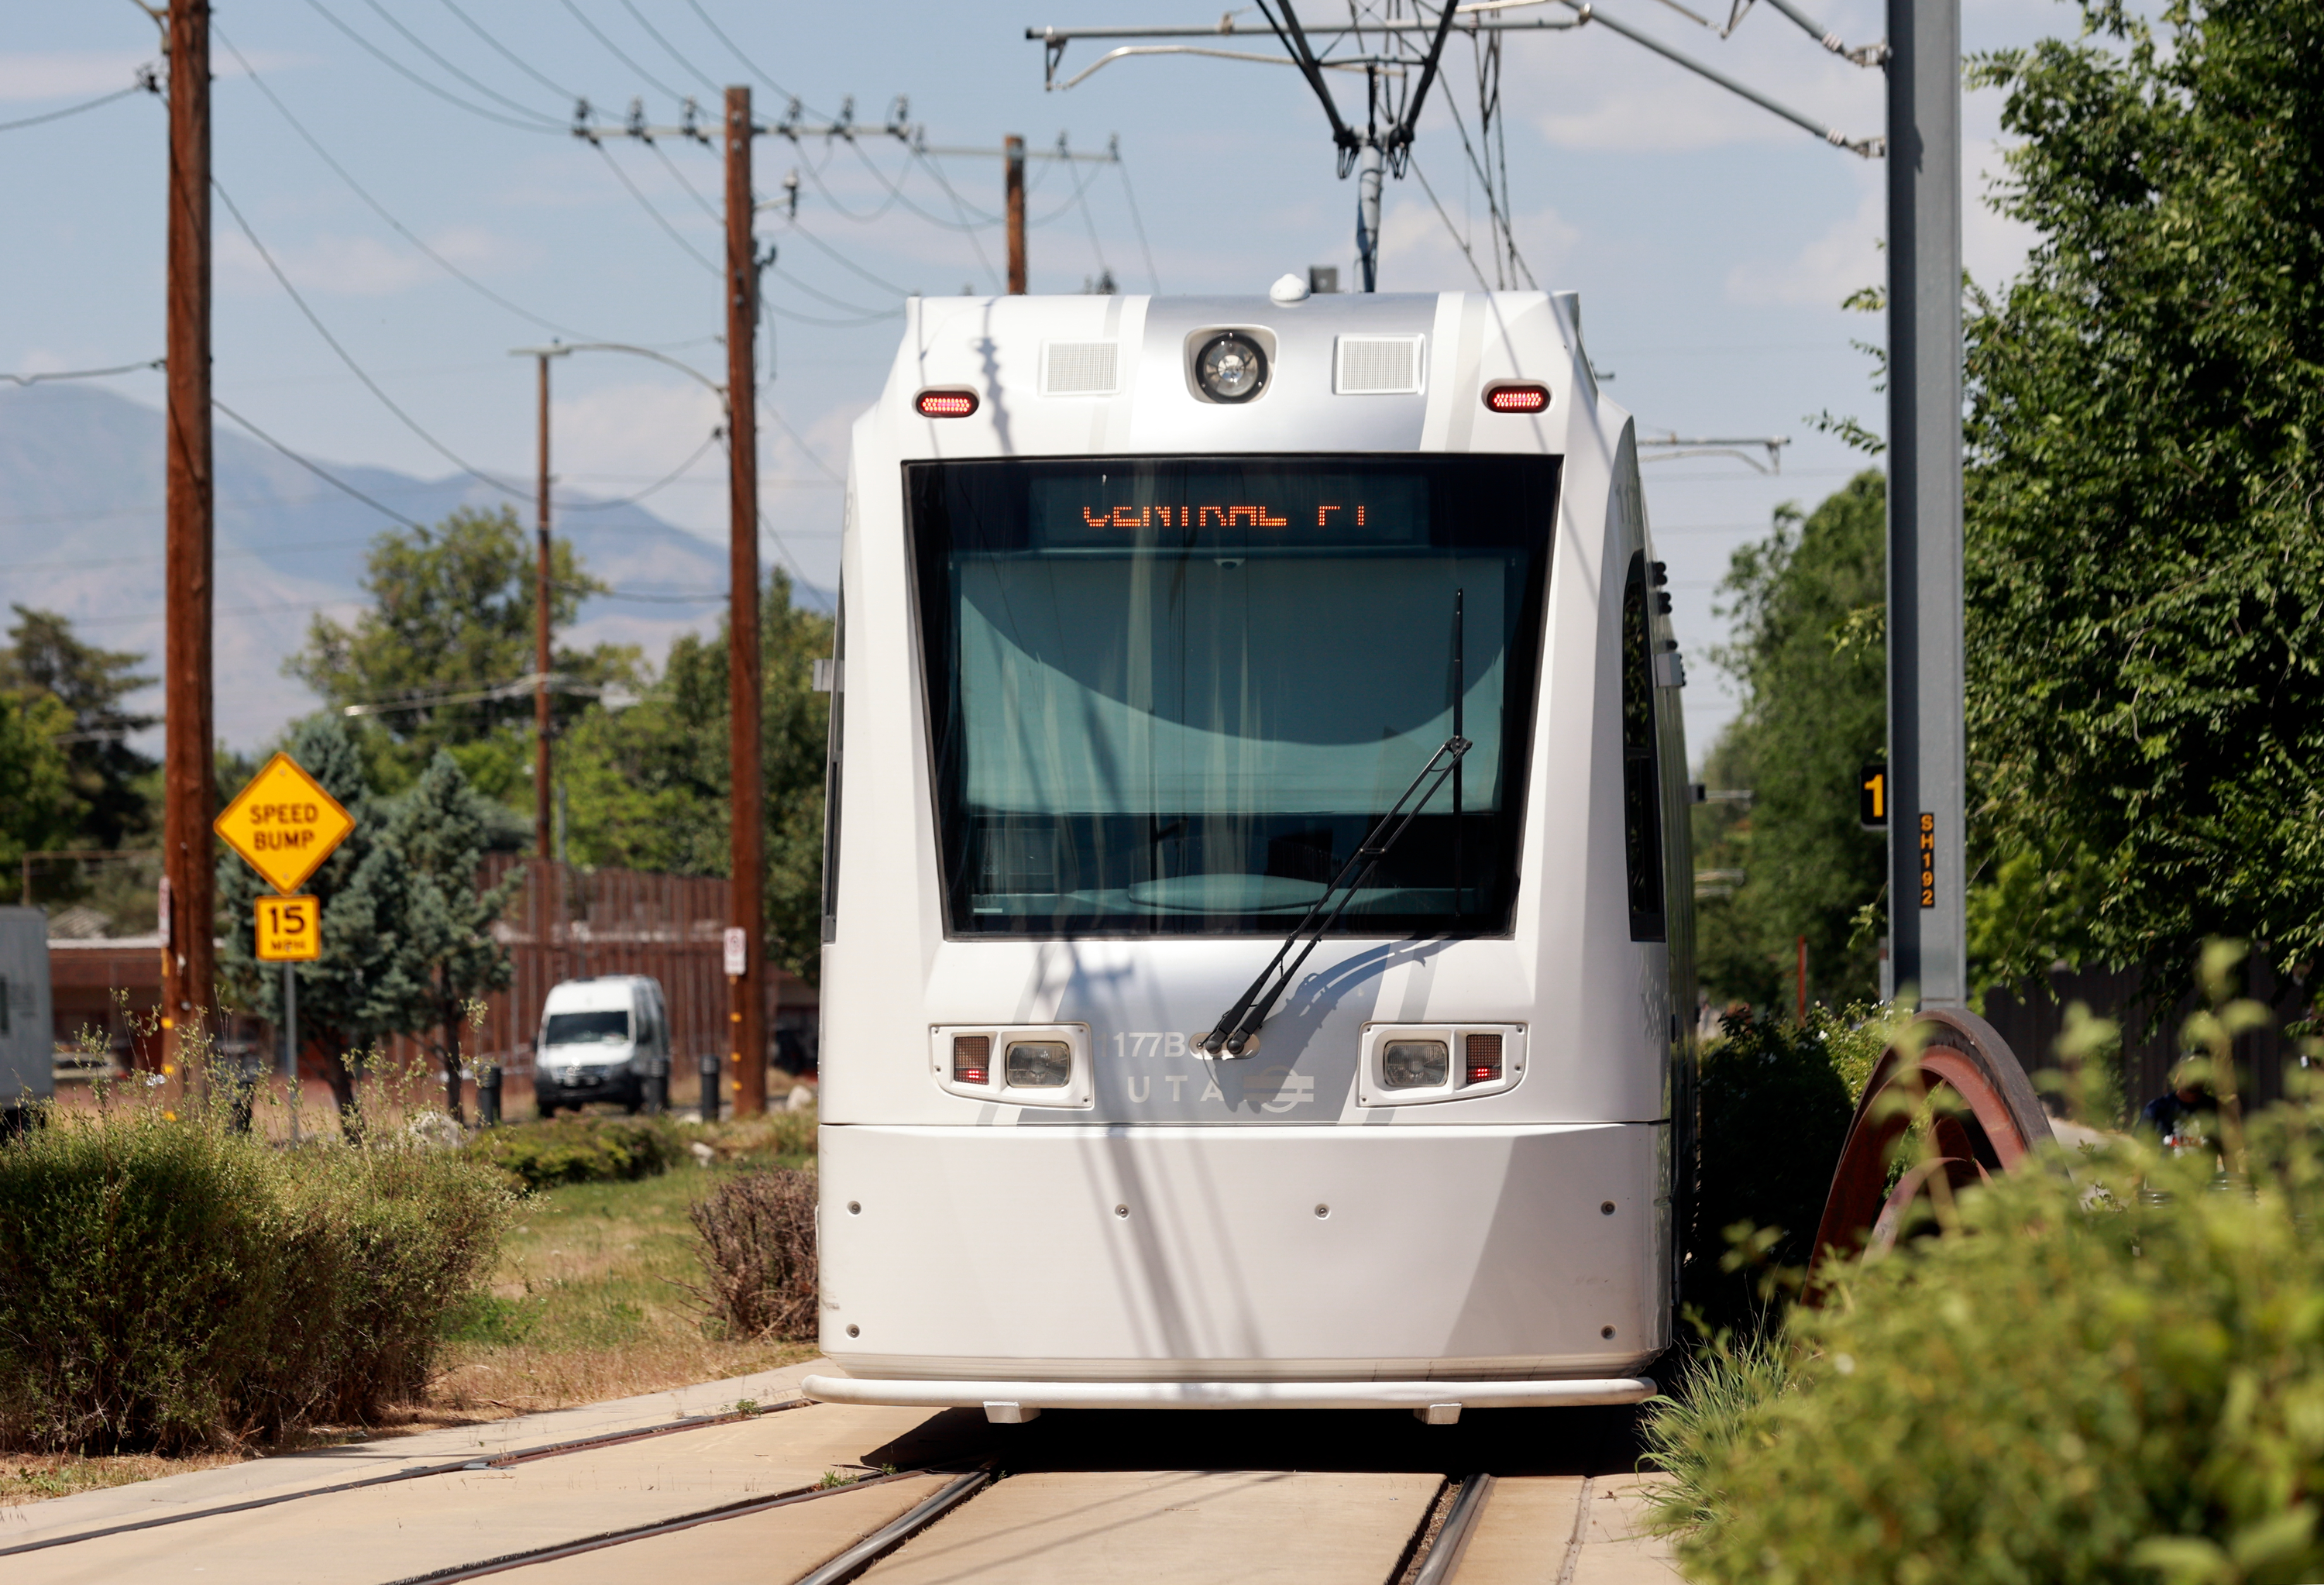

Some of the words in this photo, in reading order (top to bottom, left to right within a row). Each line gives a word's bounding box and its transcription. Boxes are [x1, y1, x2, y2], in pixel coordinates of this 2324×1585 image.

[1864, 774, 1883, 817] 1
[249, 803, 319, 825] SPEED
[254, 829, 315, 851] BUMP
[1920, 814, 1934, 906] SH192
[269, 906, 305, 934] 15
[271, 940, 306, 951] MPH
